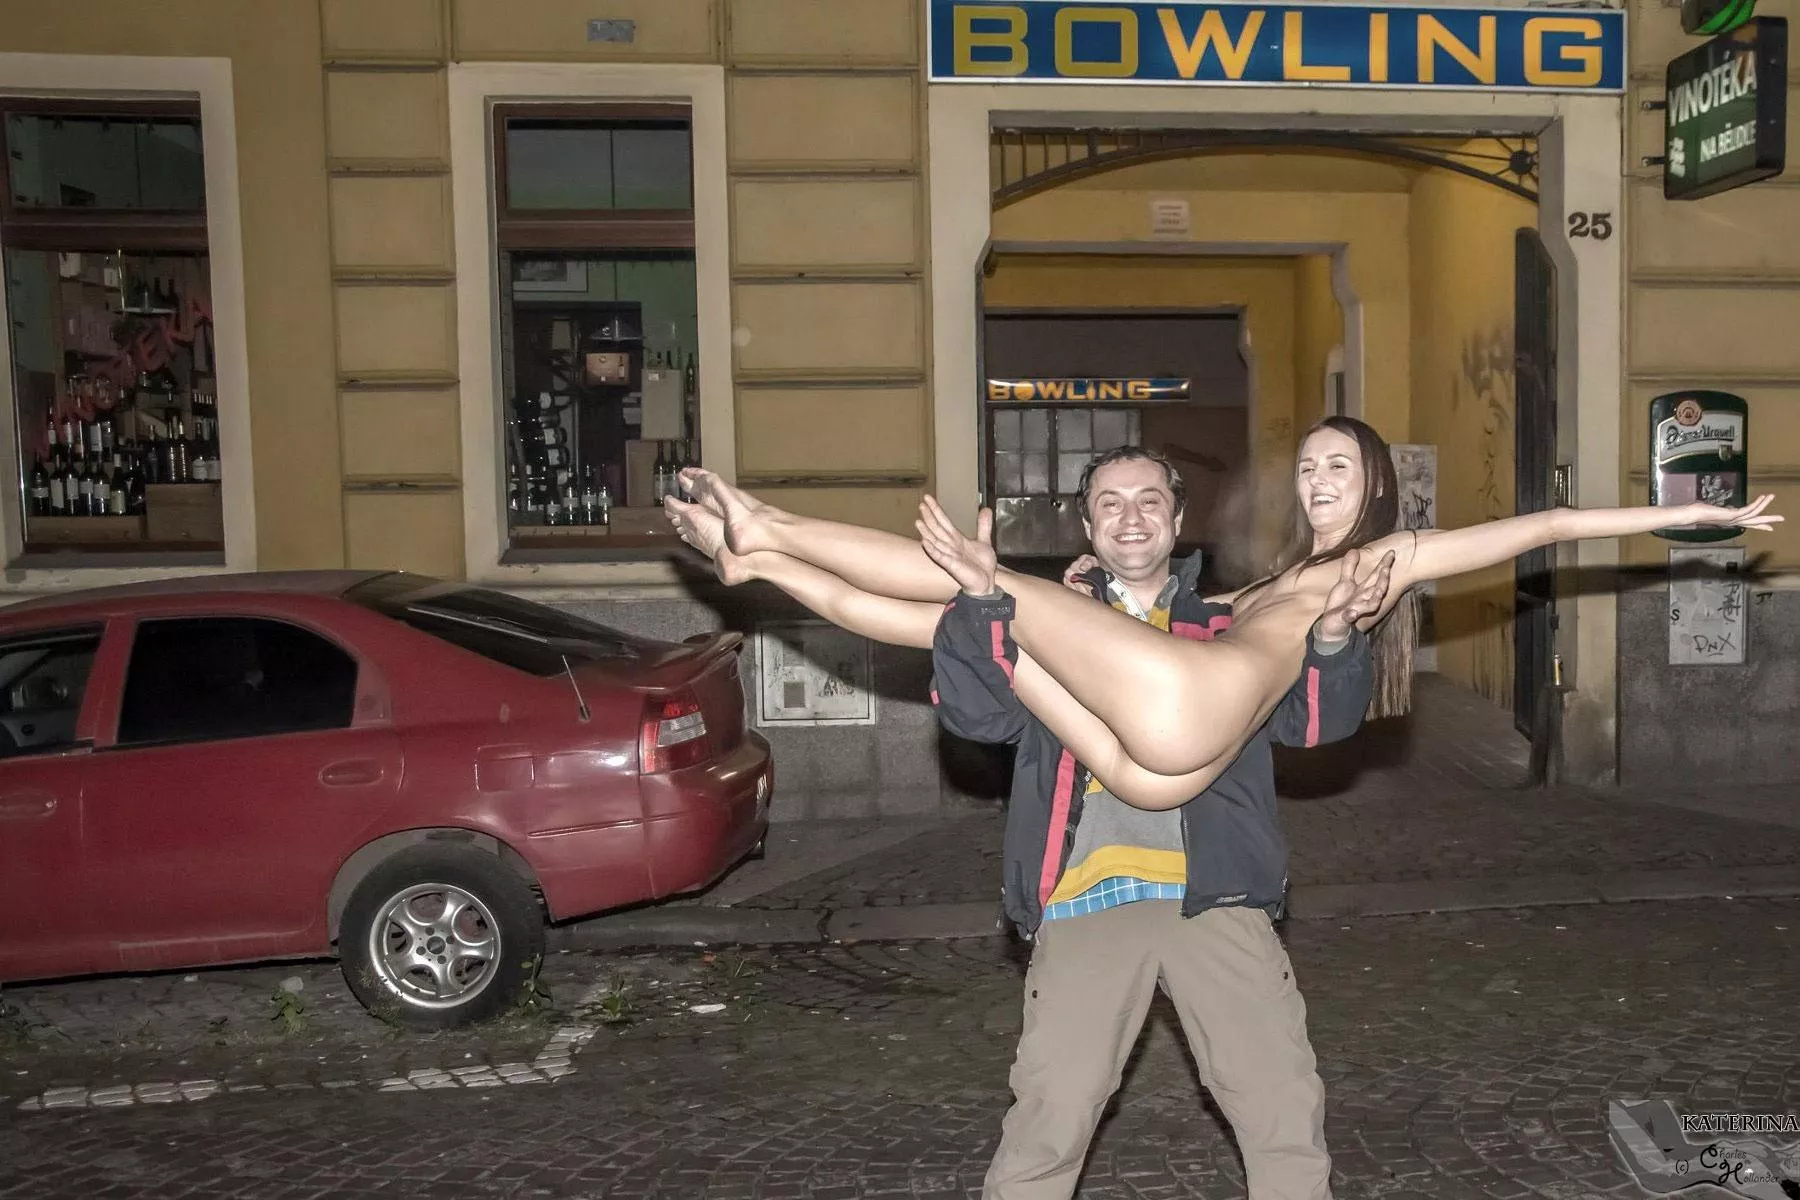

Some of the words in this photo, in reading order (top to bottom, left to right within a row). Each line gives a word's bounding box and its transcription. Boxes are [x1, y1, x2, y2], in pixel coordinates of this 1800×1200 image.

[953, 5, 1603, 86] BOWLING
[1669, 51, 1757, 127] VINOTÉKA
[1567, 211, 1613, 241] 25
[988, 380, 1152, 401] BOWLING
